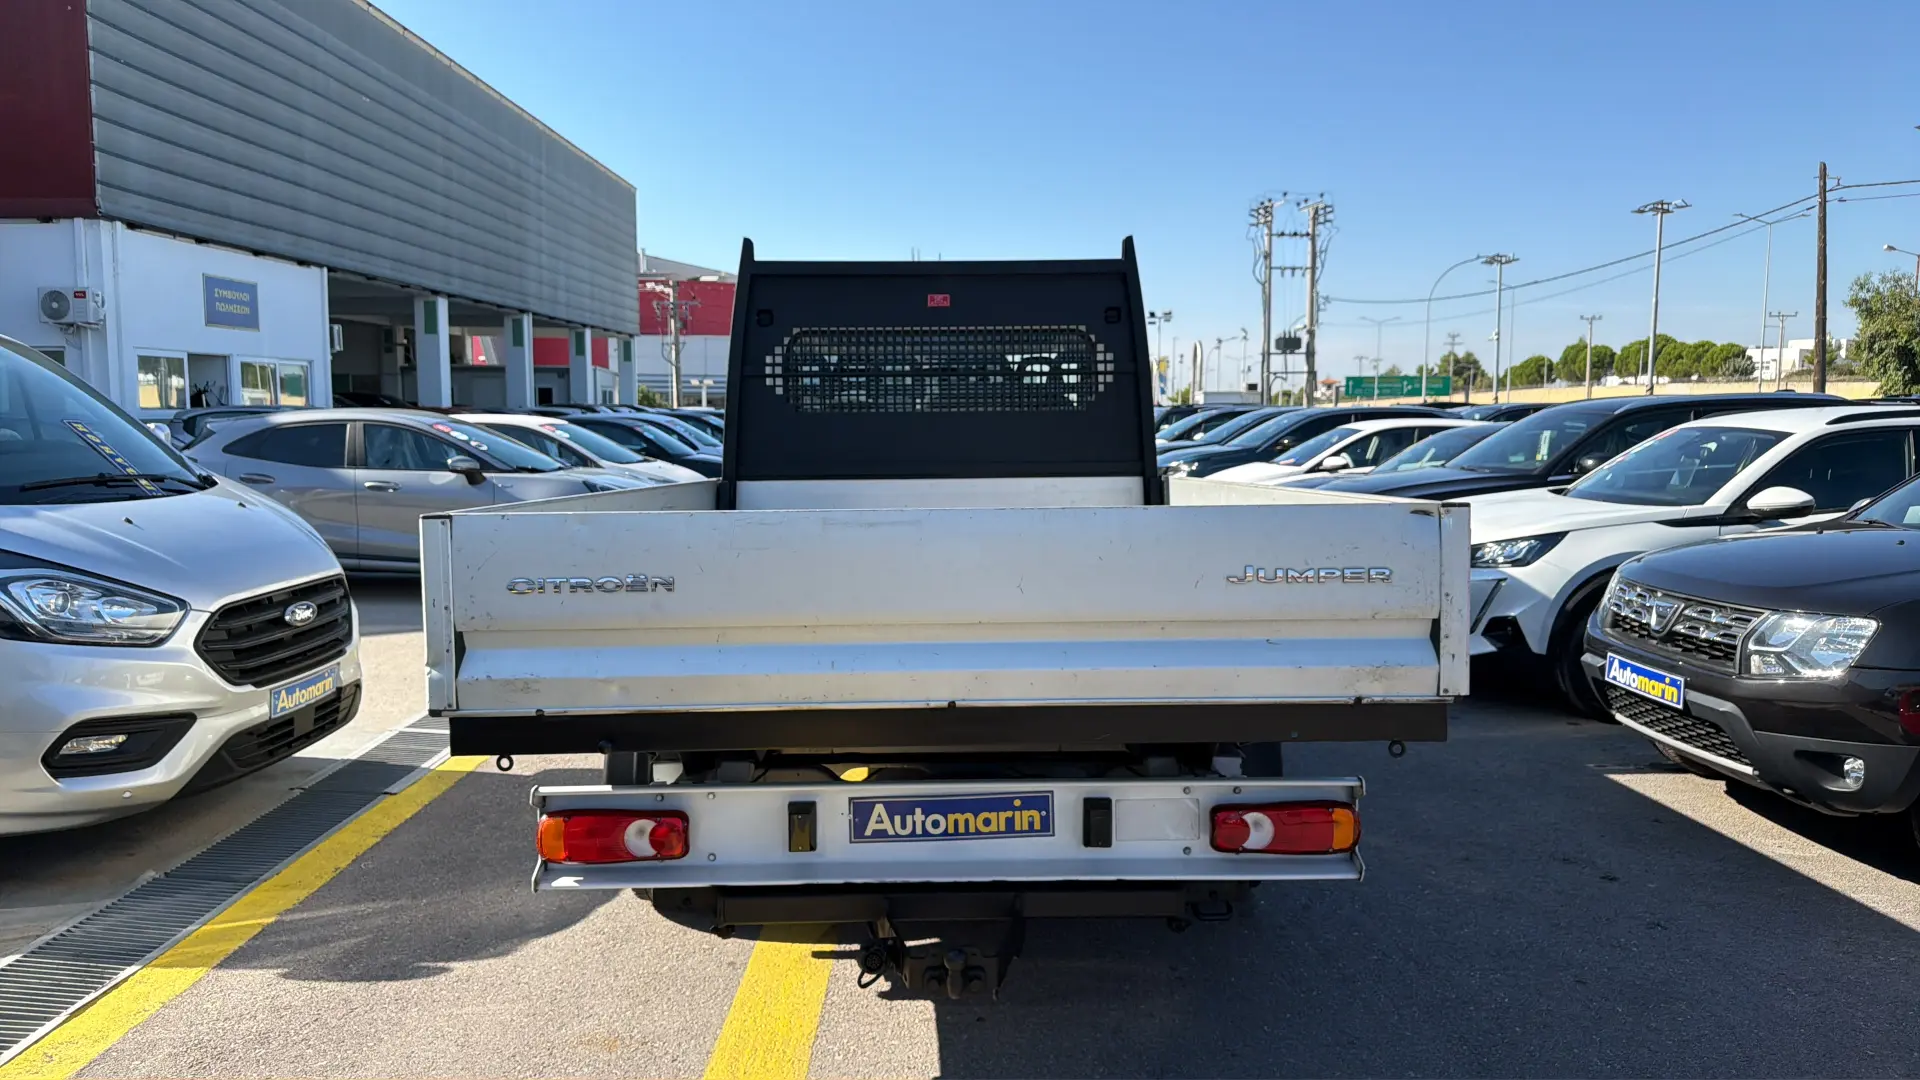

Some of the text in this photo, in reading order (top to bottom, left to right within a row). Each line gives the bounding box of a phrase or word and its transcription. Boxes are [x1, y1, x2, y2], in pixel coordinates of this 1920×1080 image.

[506, 573, 675, 595] CITROËN
[1226, 565, 1393, 584] JUMPER
[276, 672, 334, 713] Automarin
[1608, 658, 1679, 703] Automarin
[864, 799, 1041, 837] Automarin
